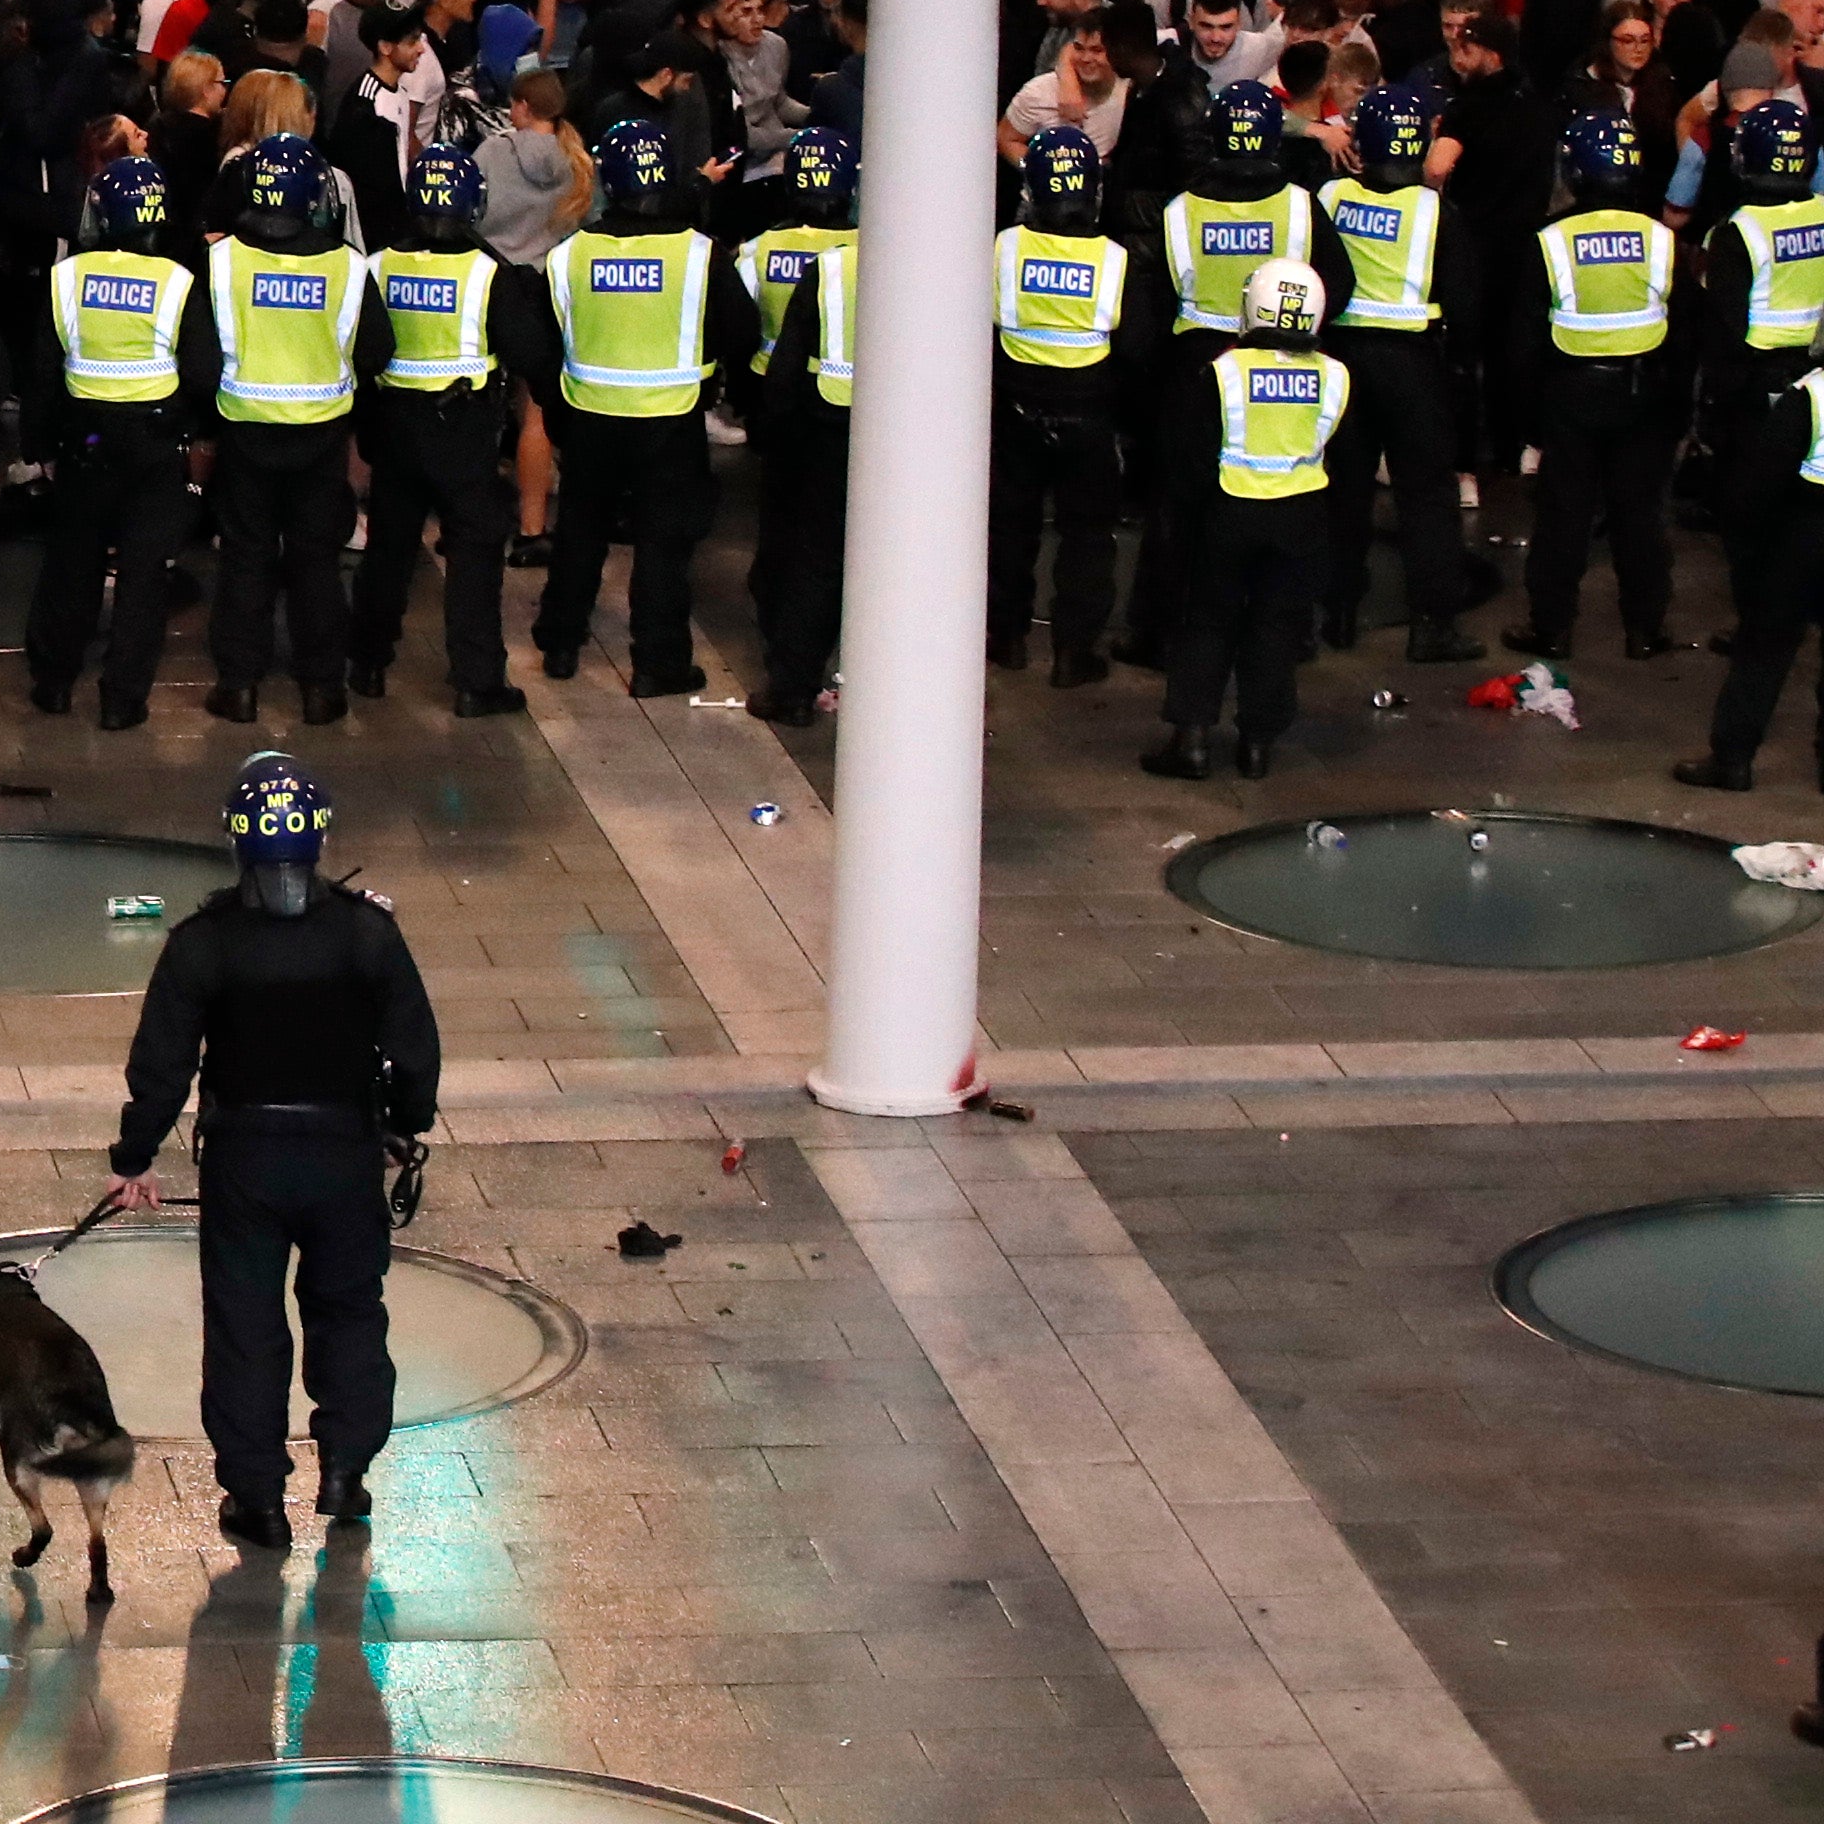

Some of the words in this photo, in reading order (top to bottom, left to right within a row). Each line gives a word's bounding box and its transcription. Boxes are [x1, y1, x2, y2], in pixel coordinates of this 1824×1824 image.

[1232, 121, 1253, 133] MP
[1397, 127, 1417, 139] MP
[1780, 130, 1801, 142] MP
[636, 153, 658, 167] MP
[800, 157, 821, 168] MP
[1053, 160, 1073, 172] MP
[256, 174, 275, 186] MP
[426, 173, 446, 185] MP
[144, 194, 163, 206] MP
[1335, 206, 1398, 237] POLICE
[1203, 225, 1271, 251] POLICE
[1576, 236, 1643, 261] POLICE
[593, 263, 660, 288] POLICE
[768, 254, 803, 279] POL
[1023, 263, 1093, 294] POLICE
[84, 277, 155, 310] POLICE
[255, 278, 323, 305] POLICE
[389, 280, 454, 308] POLICE
[1282, 298, 1303, 311] MP
[1252, 373, 1318, 400] POLICE
[266, 793, 295, 808] MP
[229, 813, 249, 835] K9
[259, 811, 305, 836] CO
